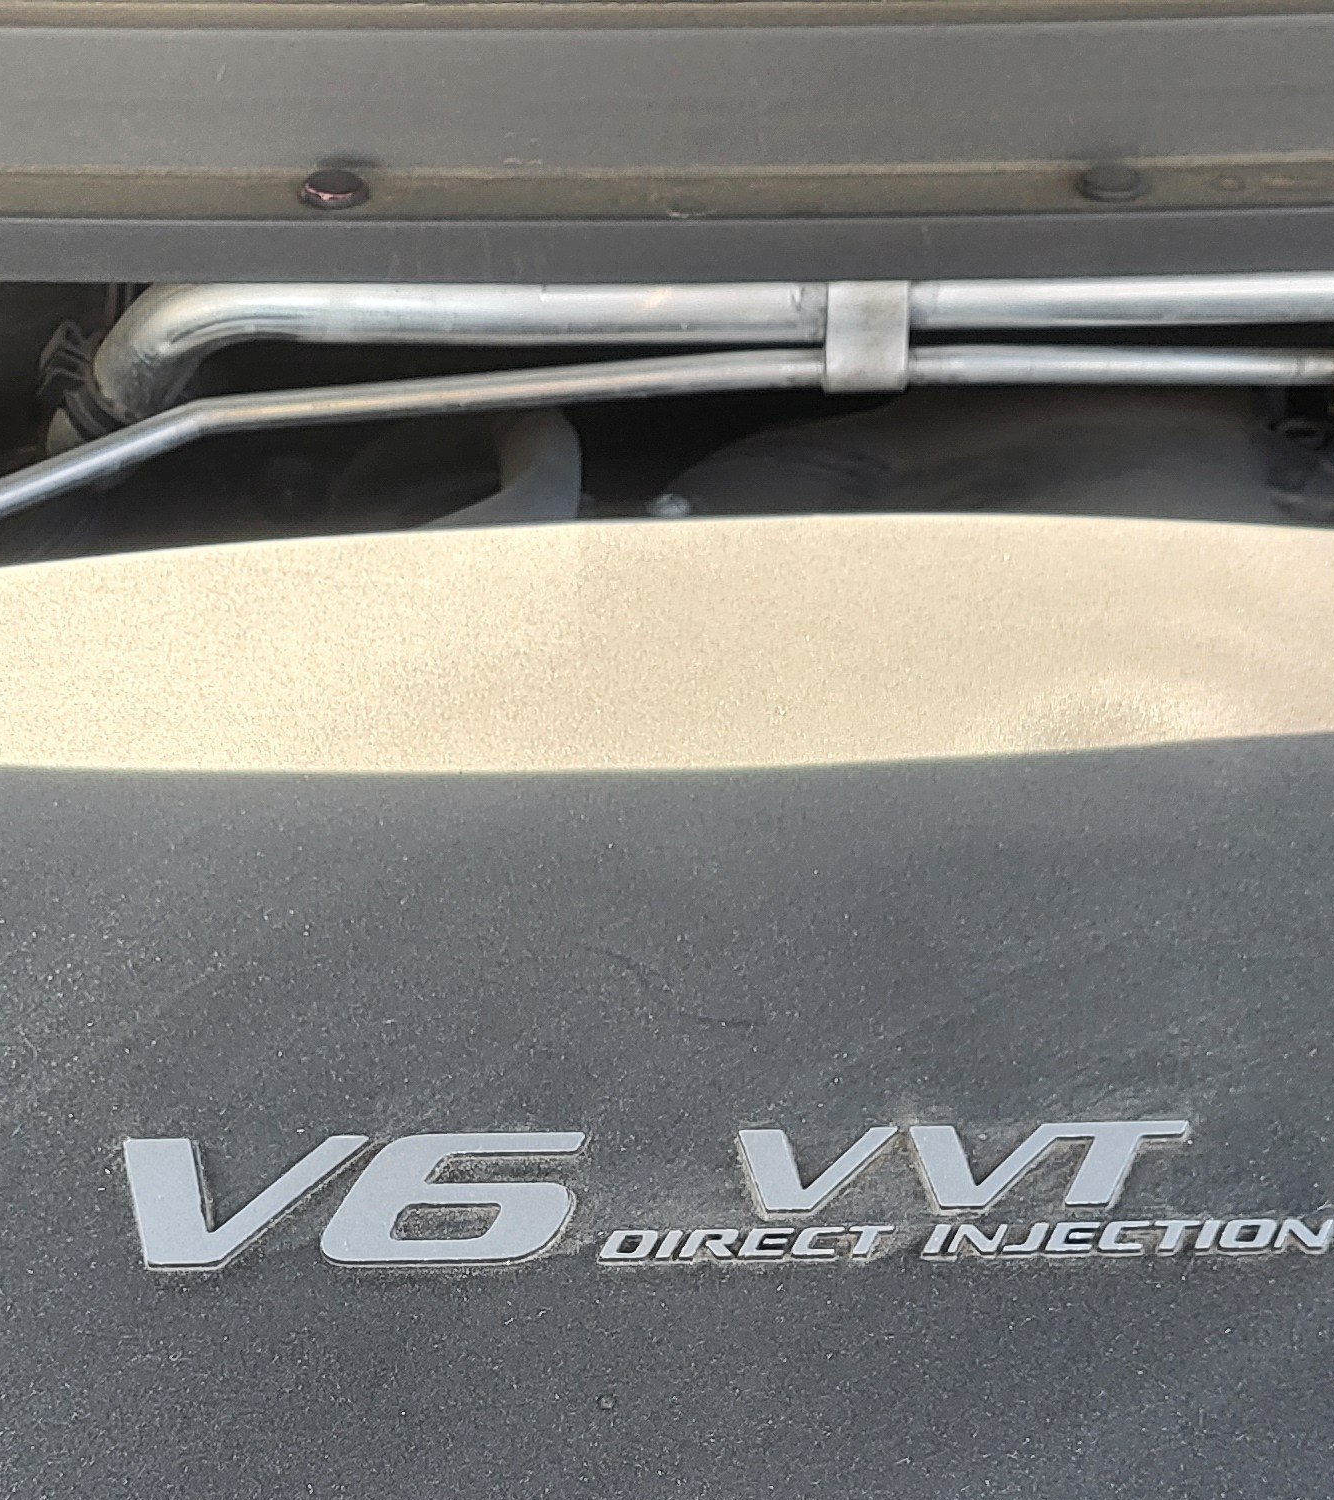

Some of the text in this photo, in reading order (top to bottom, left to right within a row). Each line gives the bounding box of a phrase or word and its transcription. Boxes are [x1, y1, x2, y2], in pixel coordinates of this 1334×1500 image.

[123, 1131, 587, 1269] V6
[738, 1119, 1189, 1212] VVT
[597, 1223, 895, 1261] DIRECT
